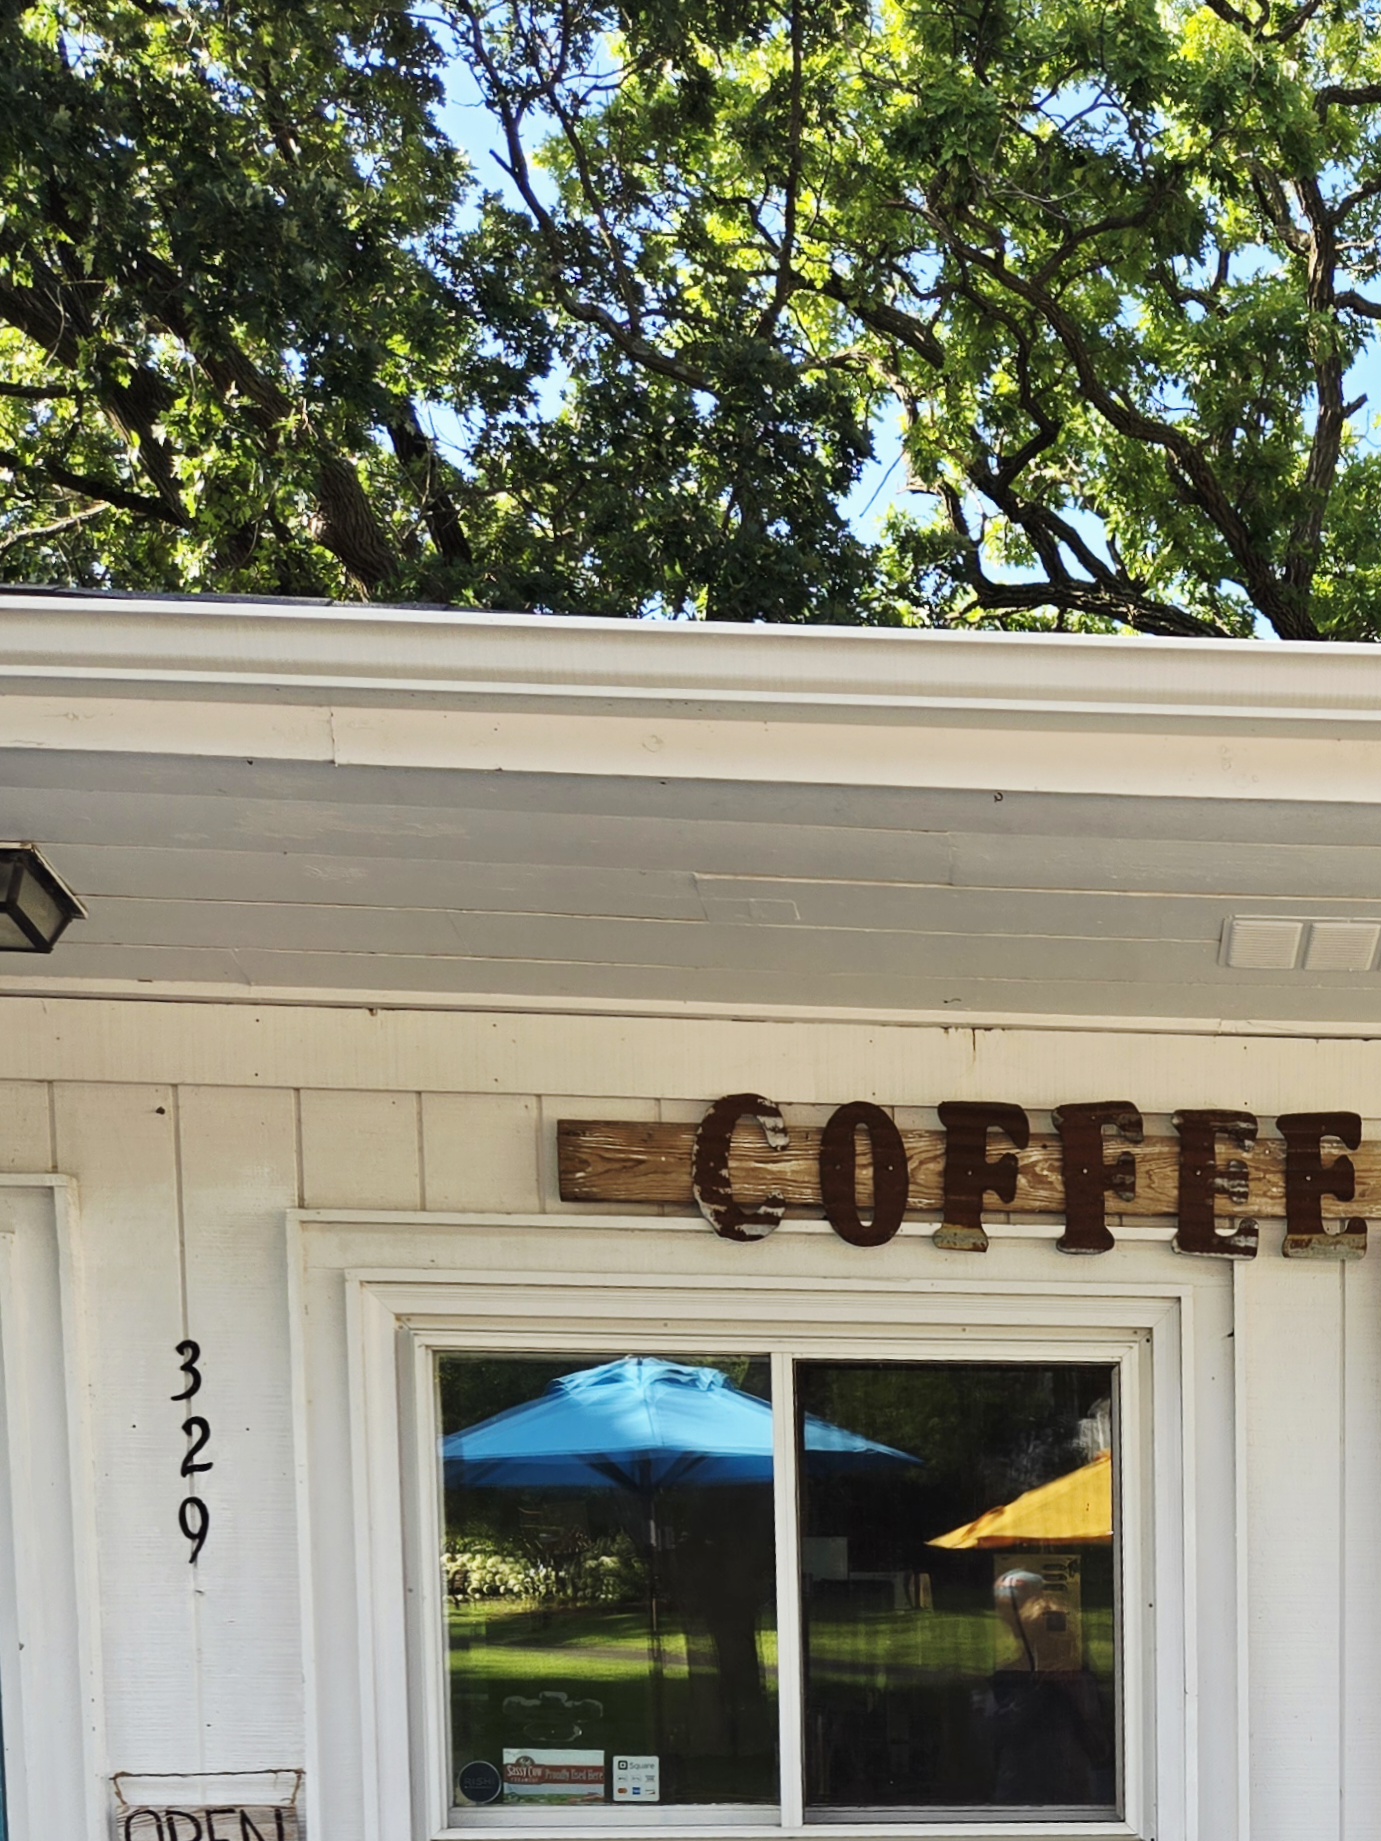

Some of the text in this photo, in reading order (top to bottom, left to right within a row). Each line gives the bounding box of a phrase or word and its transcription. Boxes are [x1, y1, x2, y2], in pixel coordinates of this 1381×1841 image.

[691, 1092, 1368, 1260] COFFEE
[170, 1340, 213, 1564] 329
[506, 1765, 543, 1777] Sassy Cow
[629, 1762, 655, 1770] Square
[463, 1777, 496, 1786] RISHI
